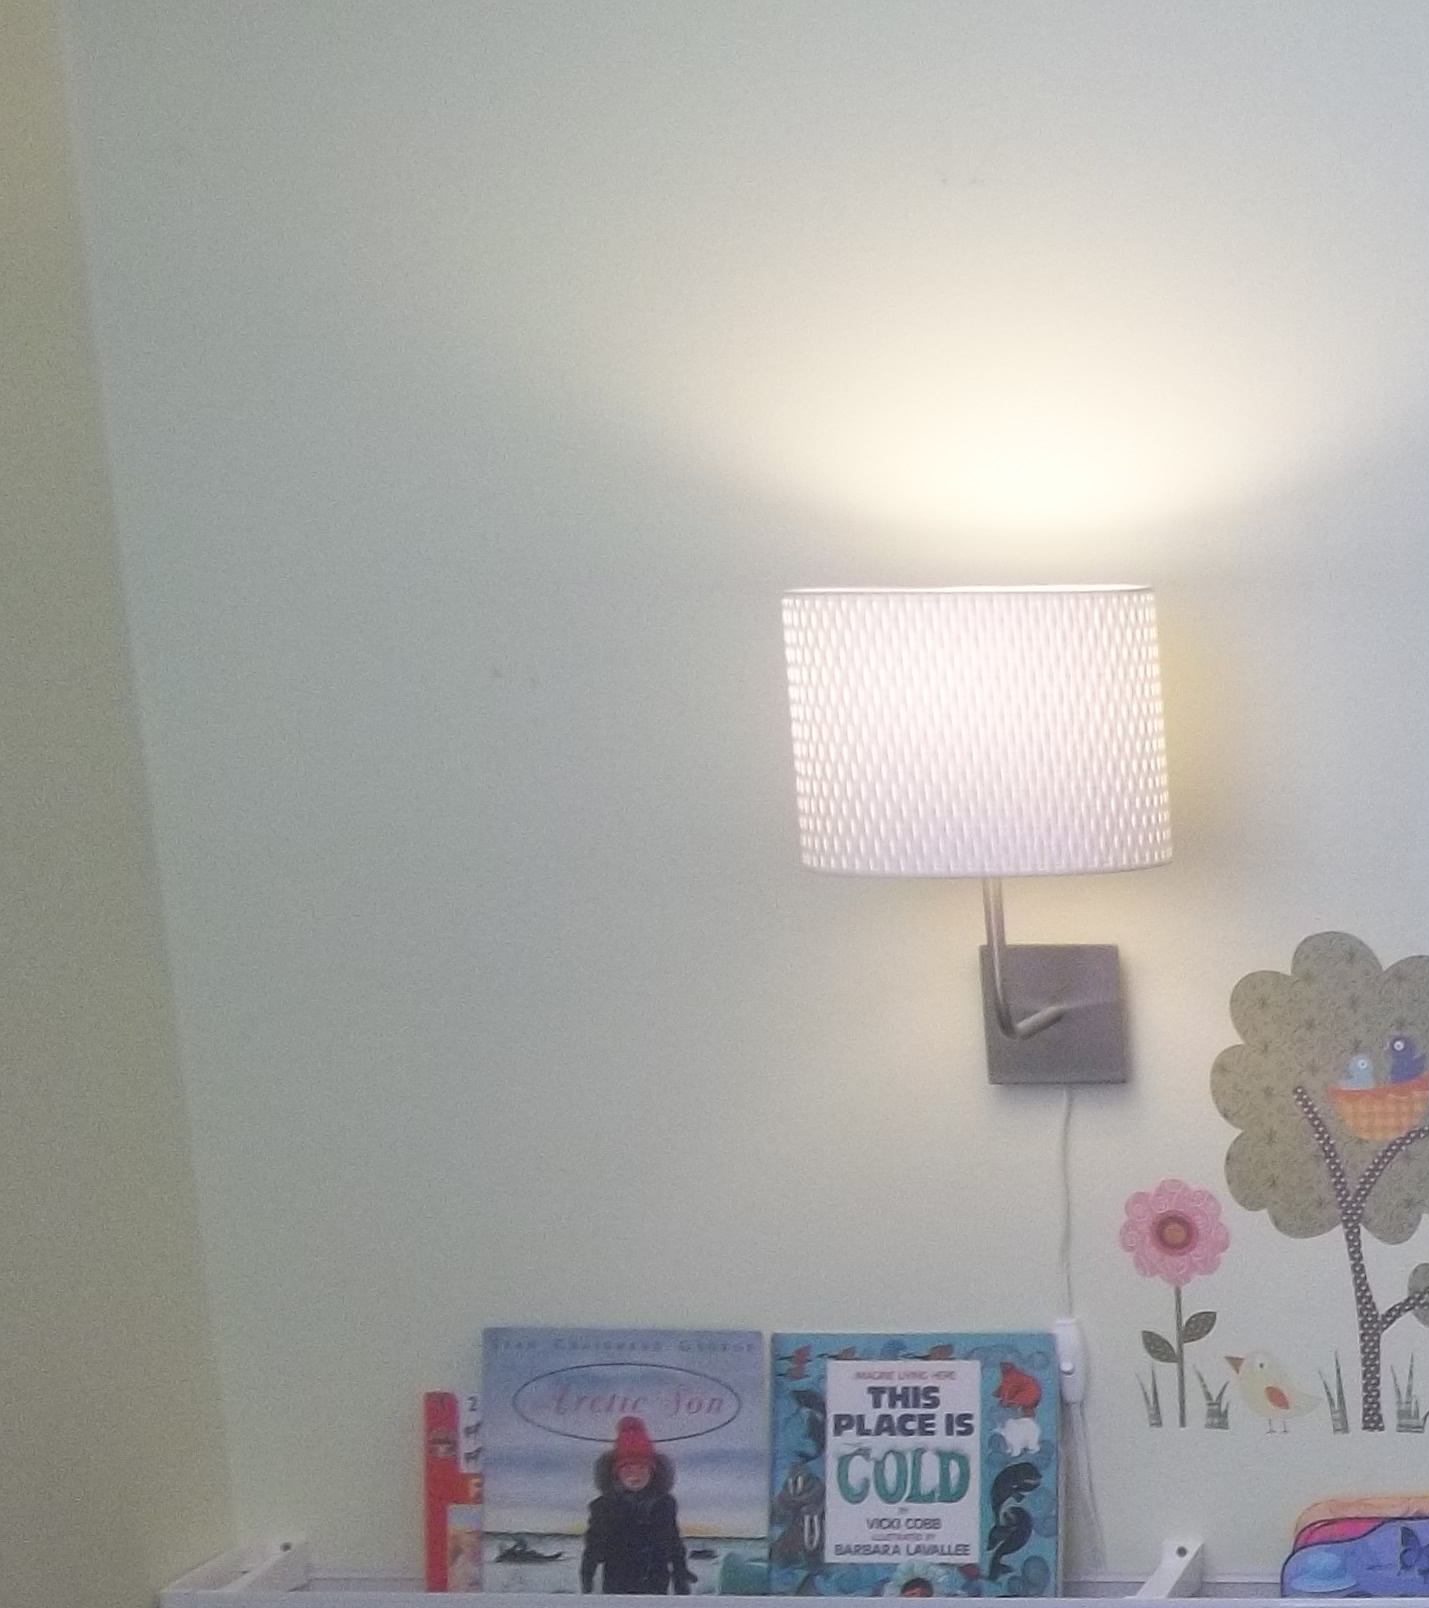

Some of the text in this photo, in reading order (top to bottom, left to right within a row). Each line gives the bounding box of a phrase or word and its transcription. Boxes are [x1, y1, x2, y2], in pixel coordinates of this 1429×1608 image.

[867, 1386, 941, 1409] THIS
[833, 1413, 974, 1437] PLACE IS
[836, 1447, 970, 1505] COLD
[866, 1518, 942, 1529] VICKI COBB
[834, 1544, 971, 1556] BARBARA LAVALLEE
